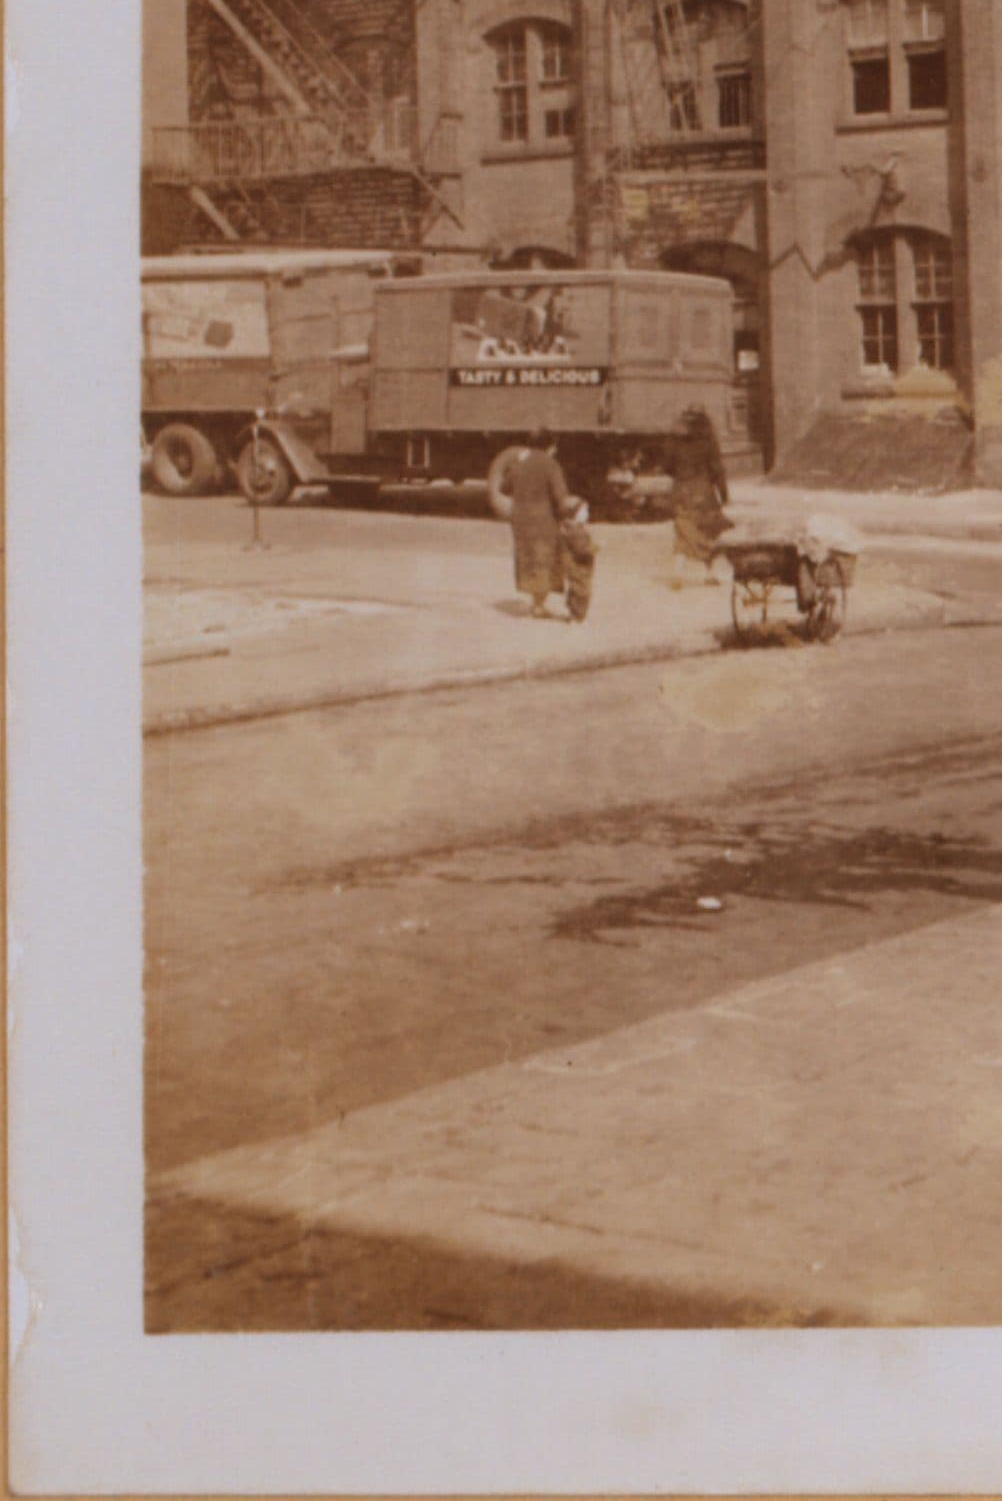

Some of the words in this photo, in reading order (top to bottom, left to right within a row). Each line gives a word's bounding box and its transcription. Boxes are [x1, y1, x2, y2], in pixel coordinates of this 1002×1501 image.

[458, 369, 502, 384] TASTY
[506, 369, 516, 383] &
[520, 368, 600, 384] DELICIOUS
